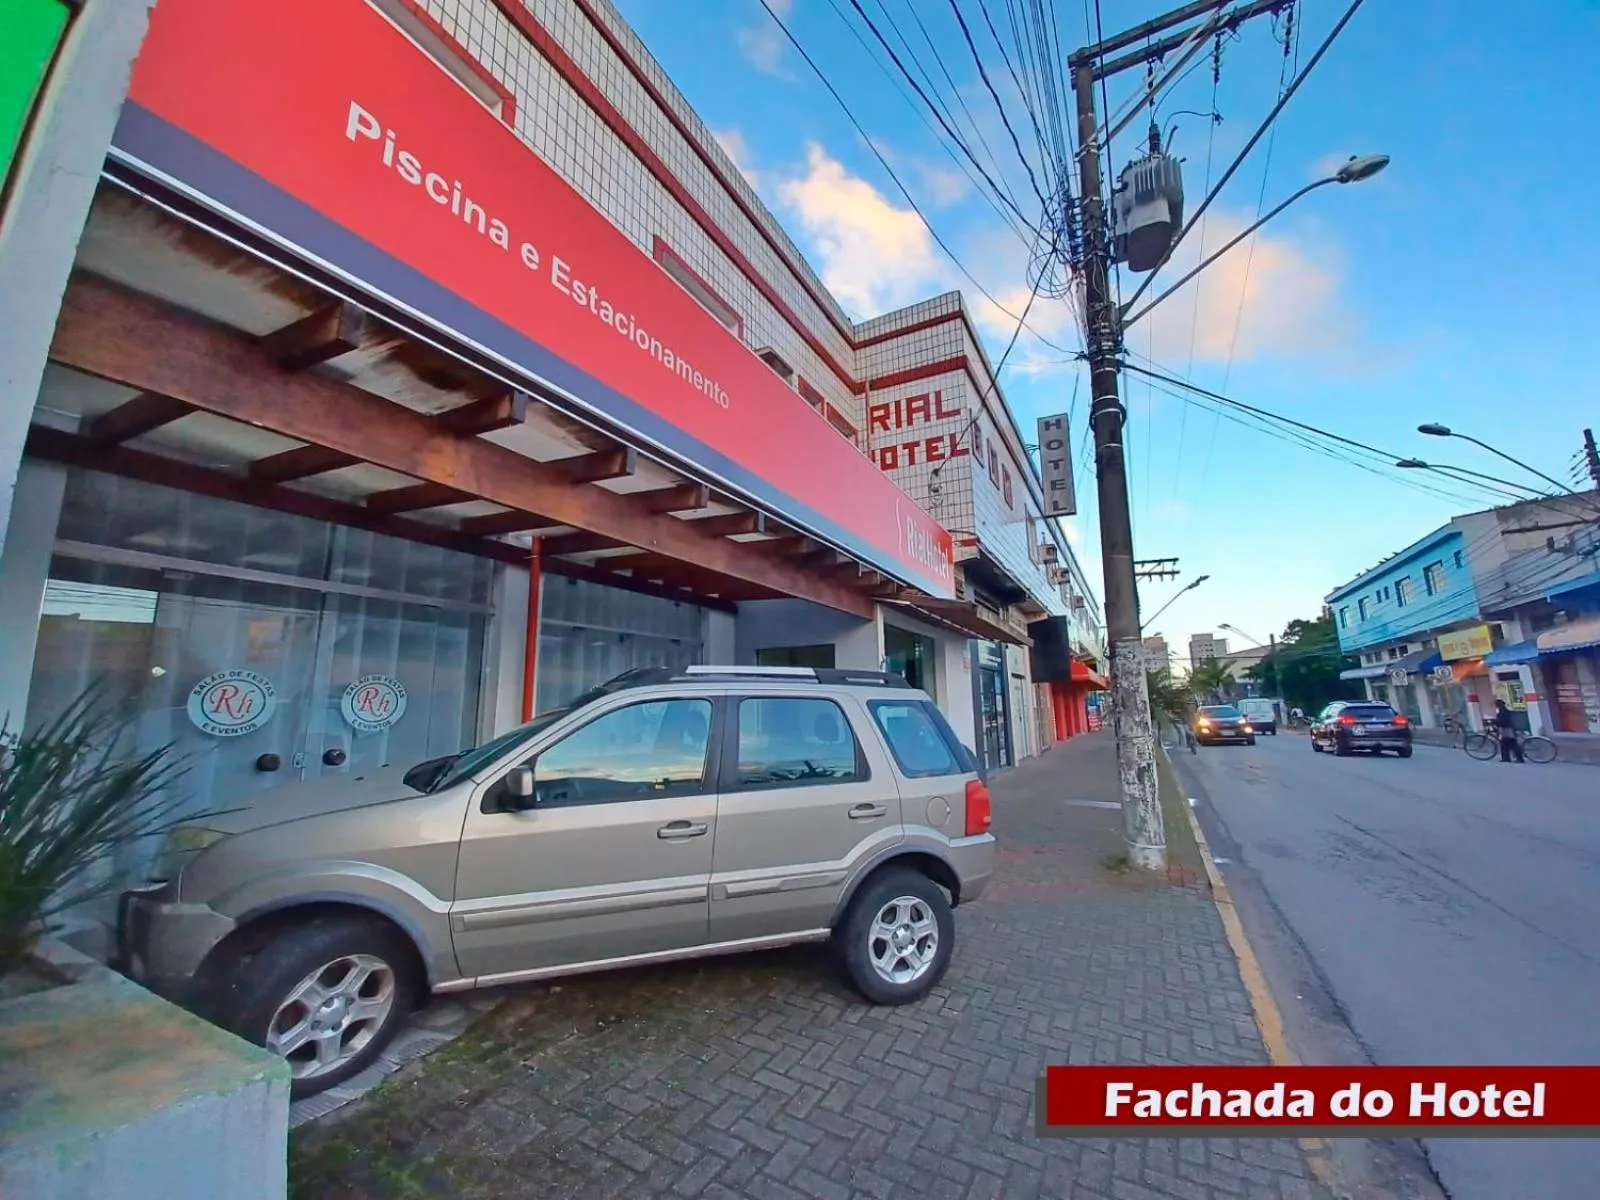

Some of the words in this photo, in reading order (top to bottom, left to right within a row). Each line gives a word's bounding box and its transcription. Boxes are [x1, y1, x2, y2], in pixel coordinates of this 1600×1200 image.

[345, 100, 510, 252] Piscina
[520, 242, 540, 271] e
[550, 255, 731, 410] Estacionamento
[869, 389, 961, 435] RIAL
[1043, 419, 1068, 512] HOTEL
[209, 684, 256, 720] Rh
[246, 671, 276, 697] FESTAS
[357, 687, 393, 718] Rh
[202, 722, 210, 730] E
[210, 722, 258, 735] EVENTOS
